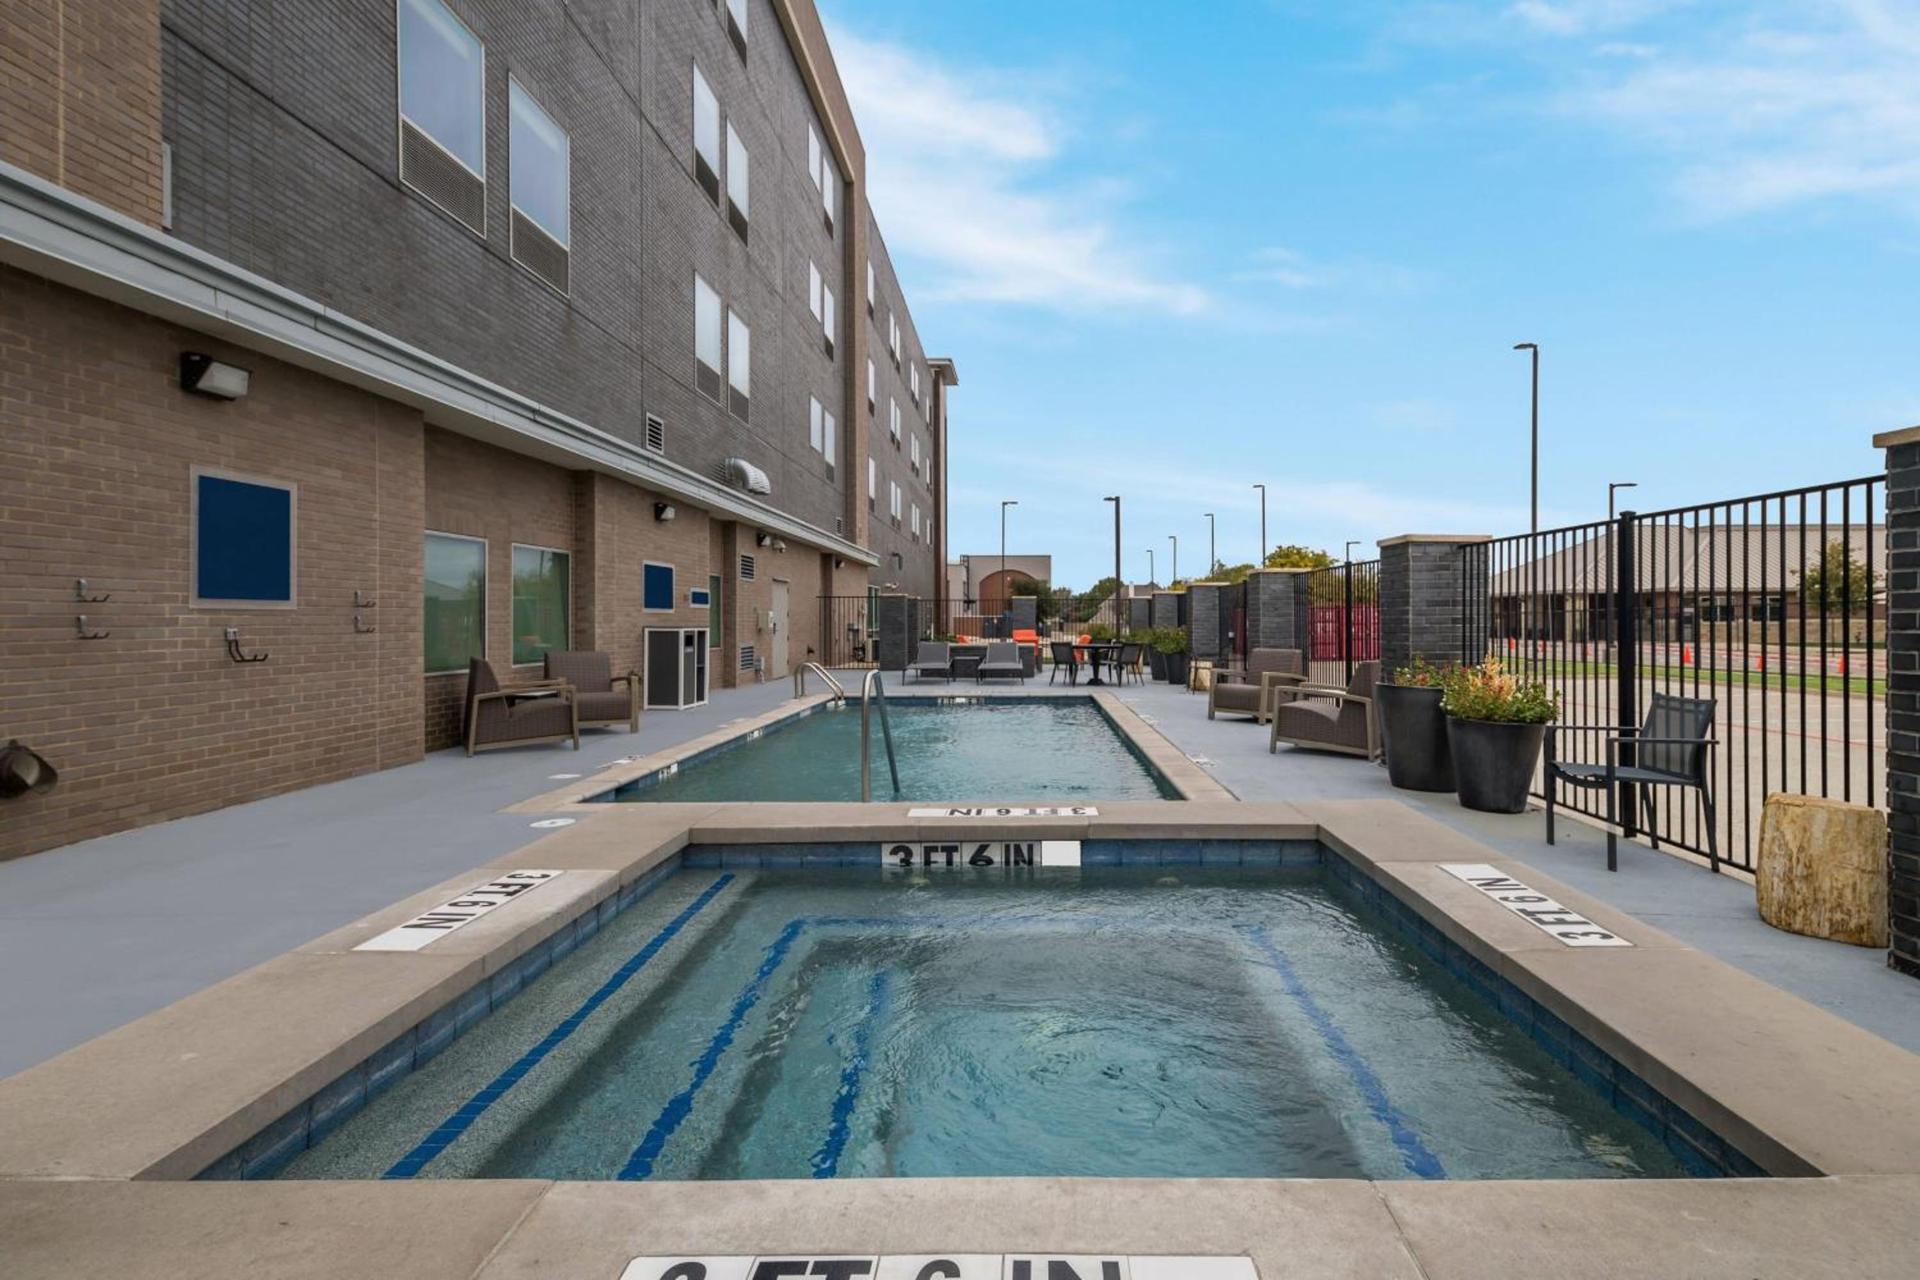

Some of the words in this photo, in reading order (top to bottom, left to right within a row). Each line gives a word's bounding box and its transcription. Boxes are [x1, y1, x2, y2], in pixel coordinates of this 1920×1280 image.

[949, 808, 982, 817] IN
[996, 808, 1012, 816] 6
[1024, 808, 1059, 816] FT
[1071, 807, 1087, 815] 3
[889, 845, 914, 867] 3
[924, 845, 959, 867] FT
[968, 844, 994, 867] 6
[1004, 843, 1034, 866] IN
[506, 872, 551, 880] 3
[1467, 877, 1529, 891] IN
[466, 882, 535, 897] FT
[448, 900, 498, 908] 6
[1498, 895, 1550, 904] 6
[401, 912, 477, 929] IN
[1517, 907, 1592, 926] FT
[1556, 931, 1615, 940] 3
